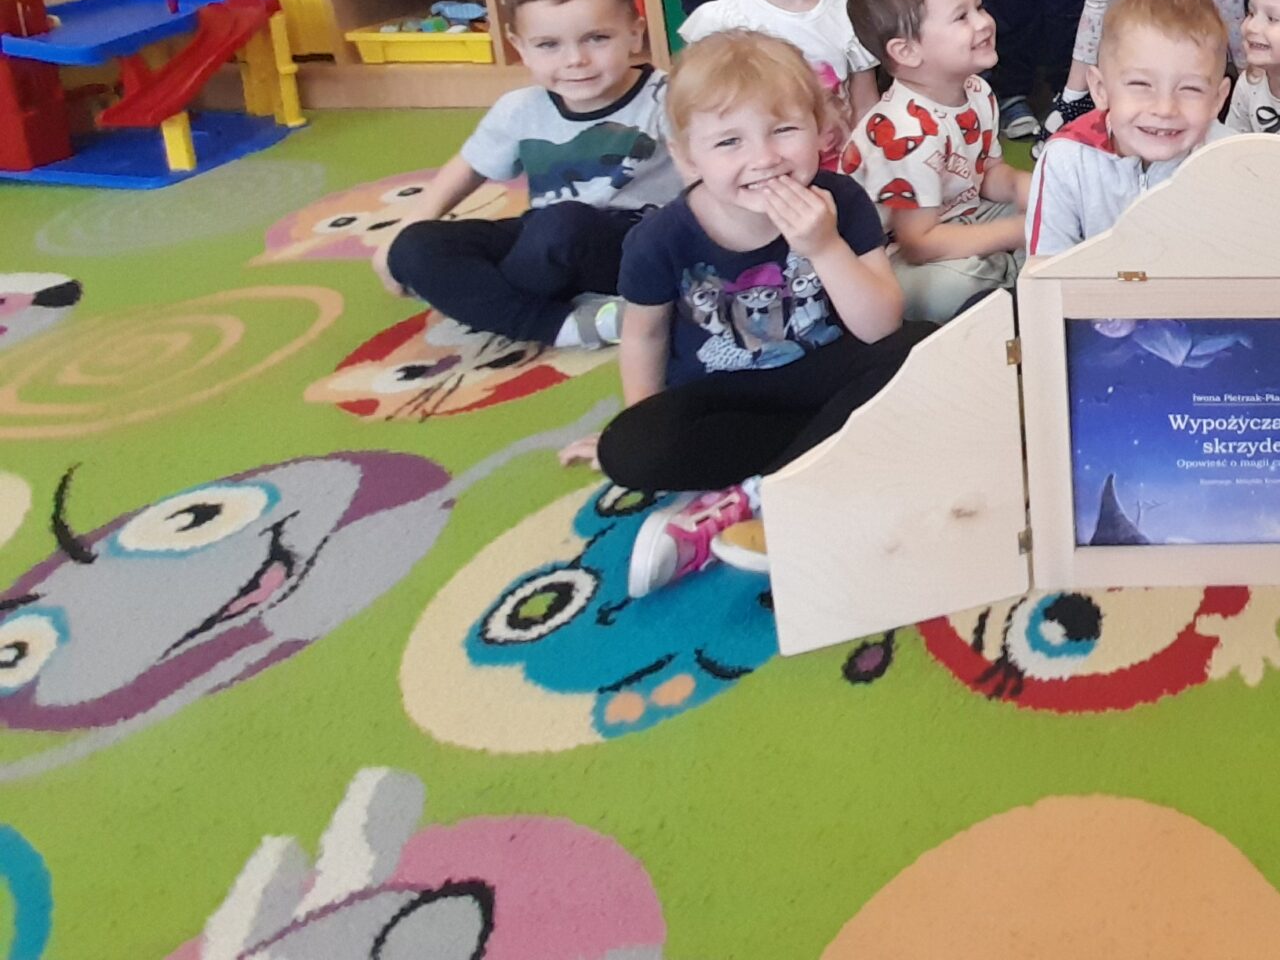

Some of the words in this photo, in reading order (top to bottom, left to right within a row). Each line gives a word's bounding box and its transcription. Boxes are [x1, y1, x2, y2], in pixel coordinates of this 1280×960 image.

[1192, 393, 1221, 402] Iwona
[1176, 458, 1227, 470] Opowieść
[1229, 459, 1237, 468] o
[1240, 458, 1270, 470] magii
